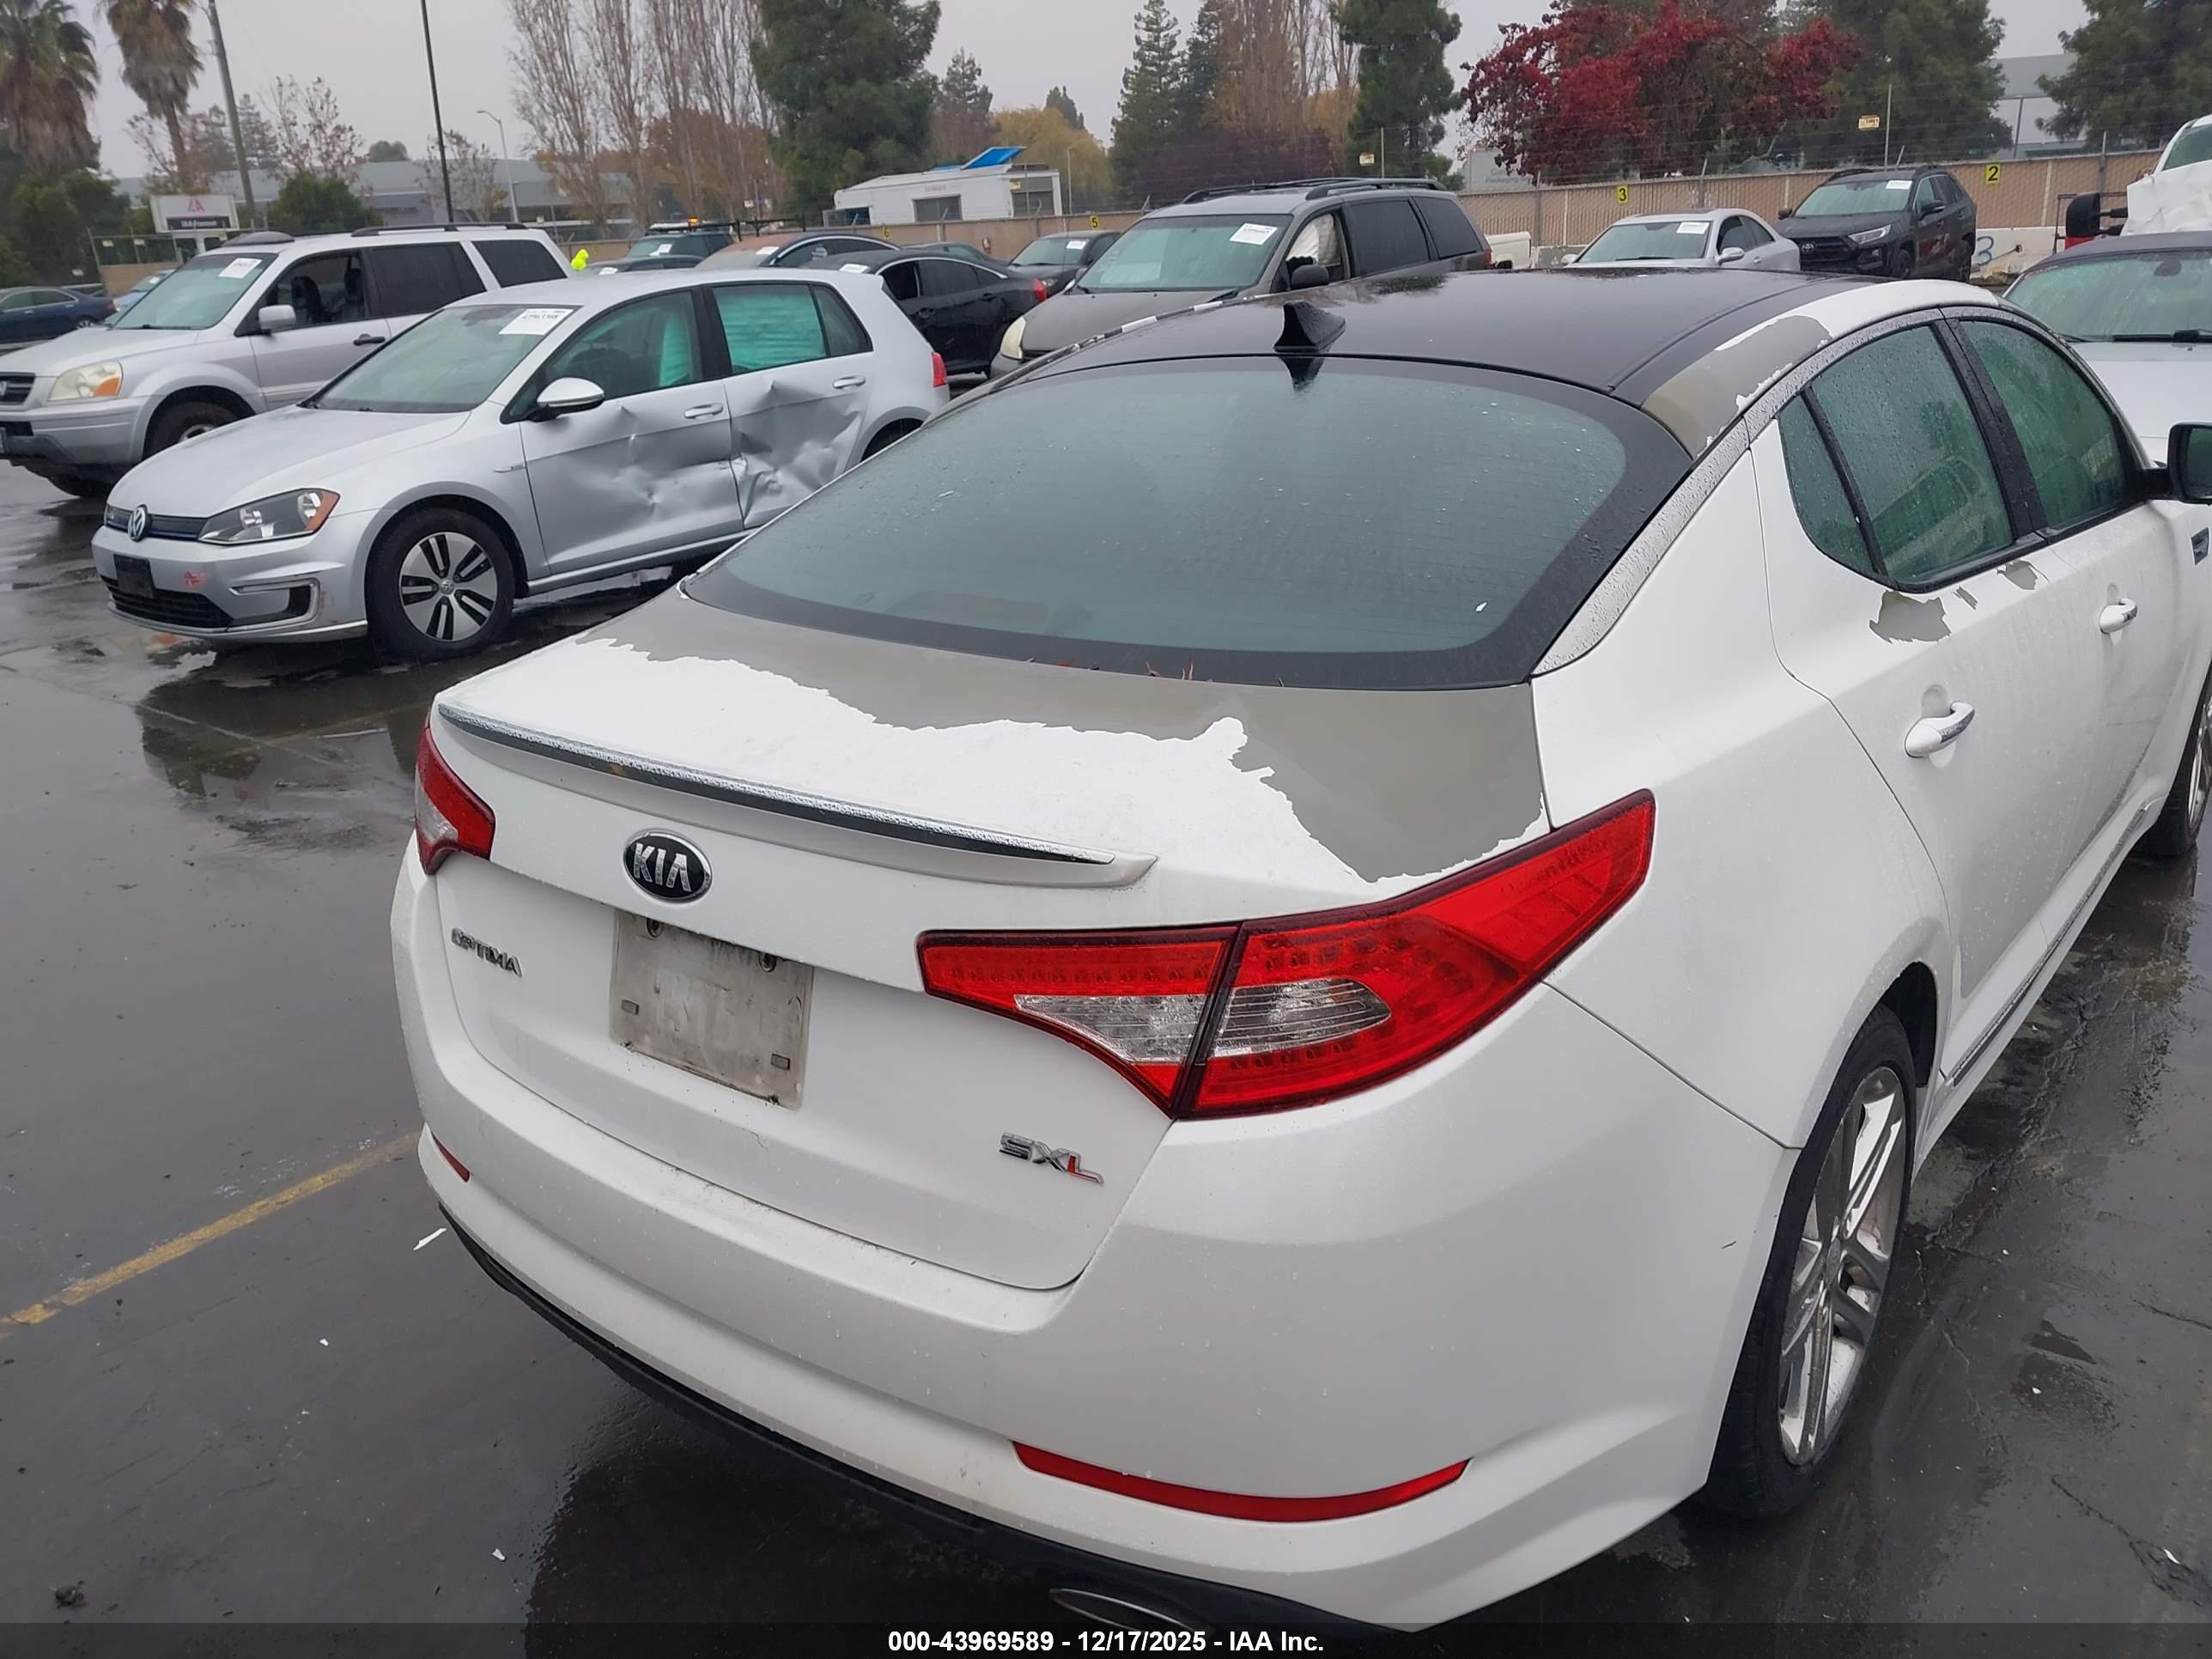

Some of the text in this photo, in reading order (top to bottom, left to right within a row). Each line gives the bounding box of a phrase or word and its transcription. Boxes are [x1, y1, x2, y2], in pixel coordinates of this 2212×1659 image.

[1987, 166, 1999, 182] 2
[1618, 187, 1627, 202] 3
[1091, 217, 1099, 228] 5
[883, 227, 890, 238] 6
[633, 842, 692, 892] KIA
[451, 927, 523, 977] OPTIMA
[999, 1132, 1104, 1184] SXL
